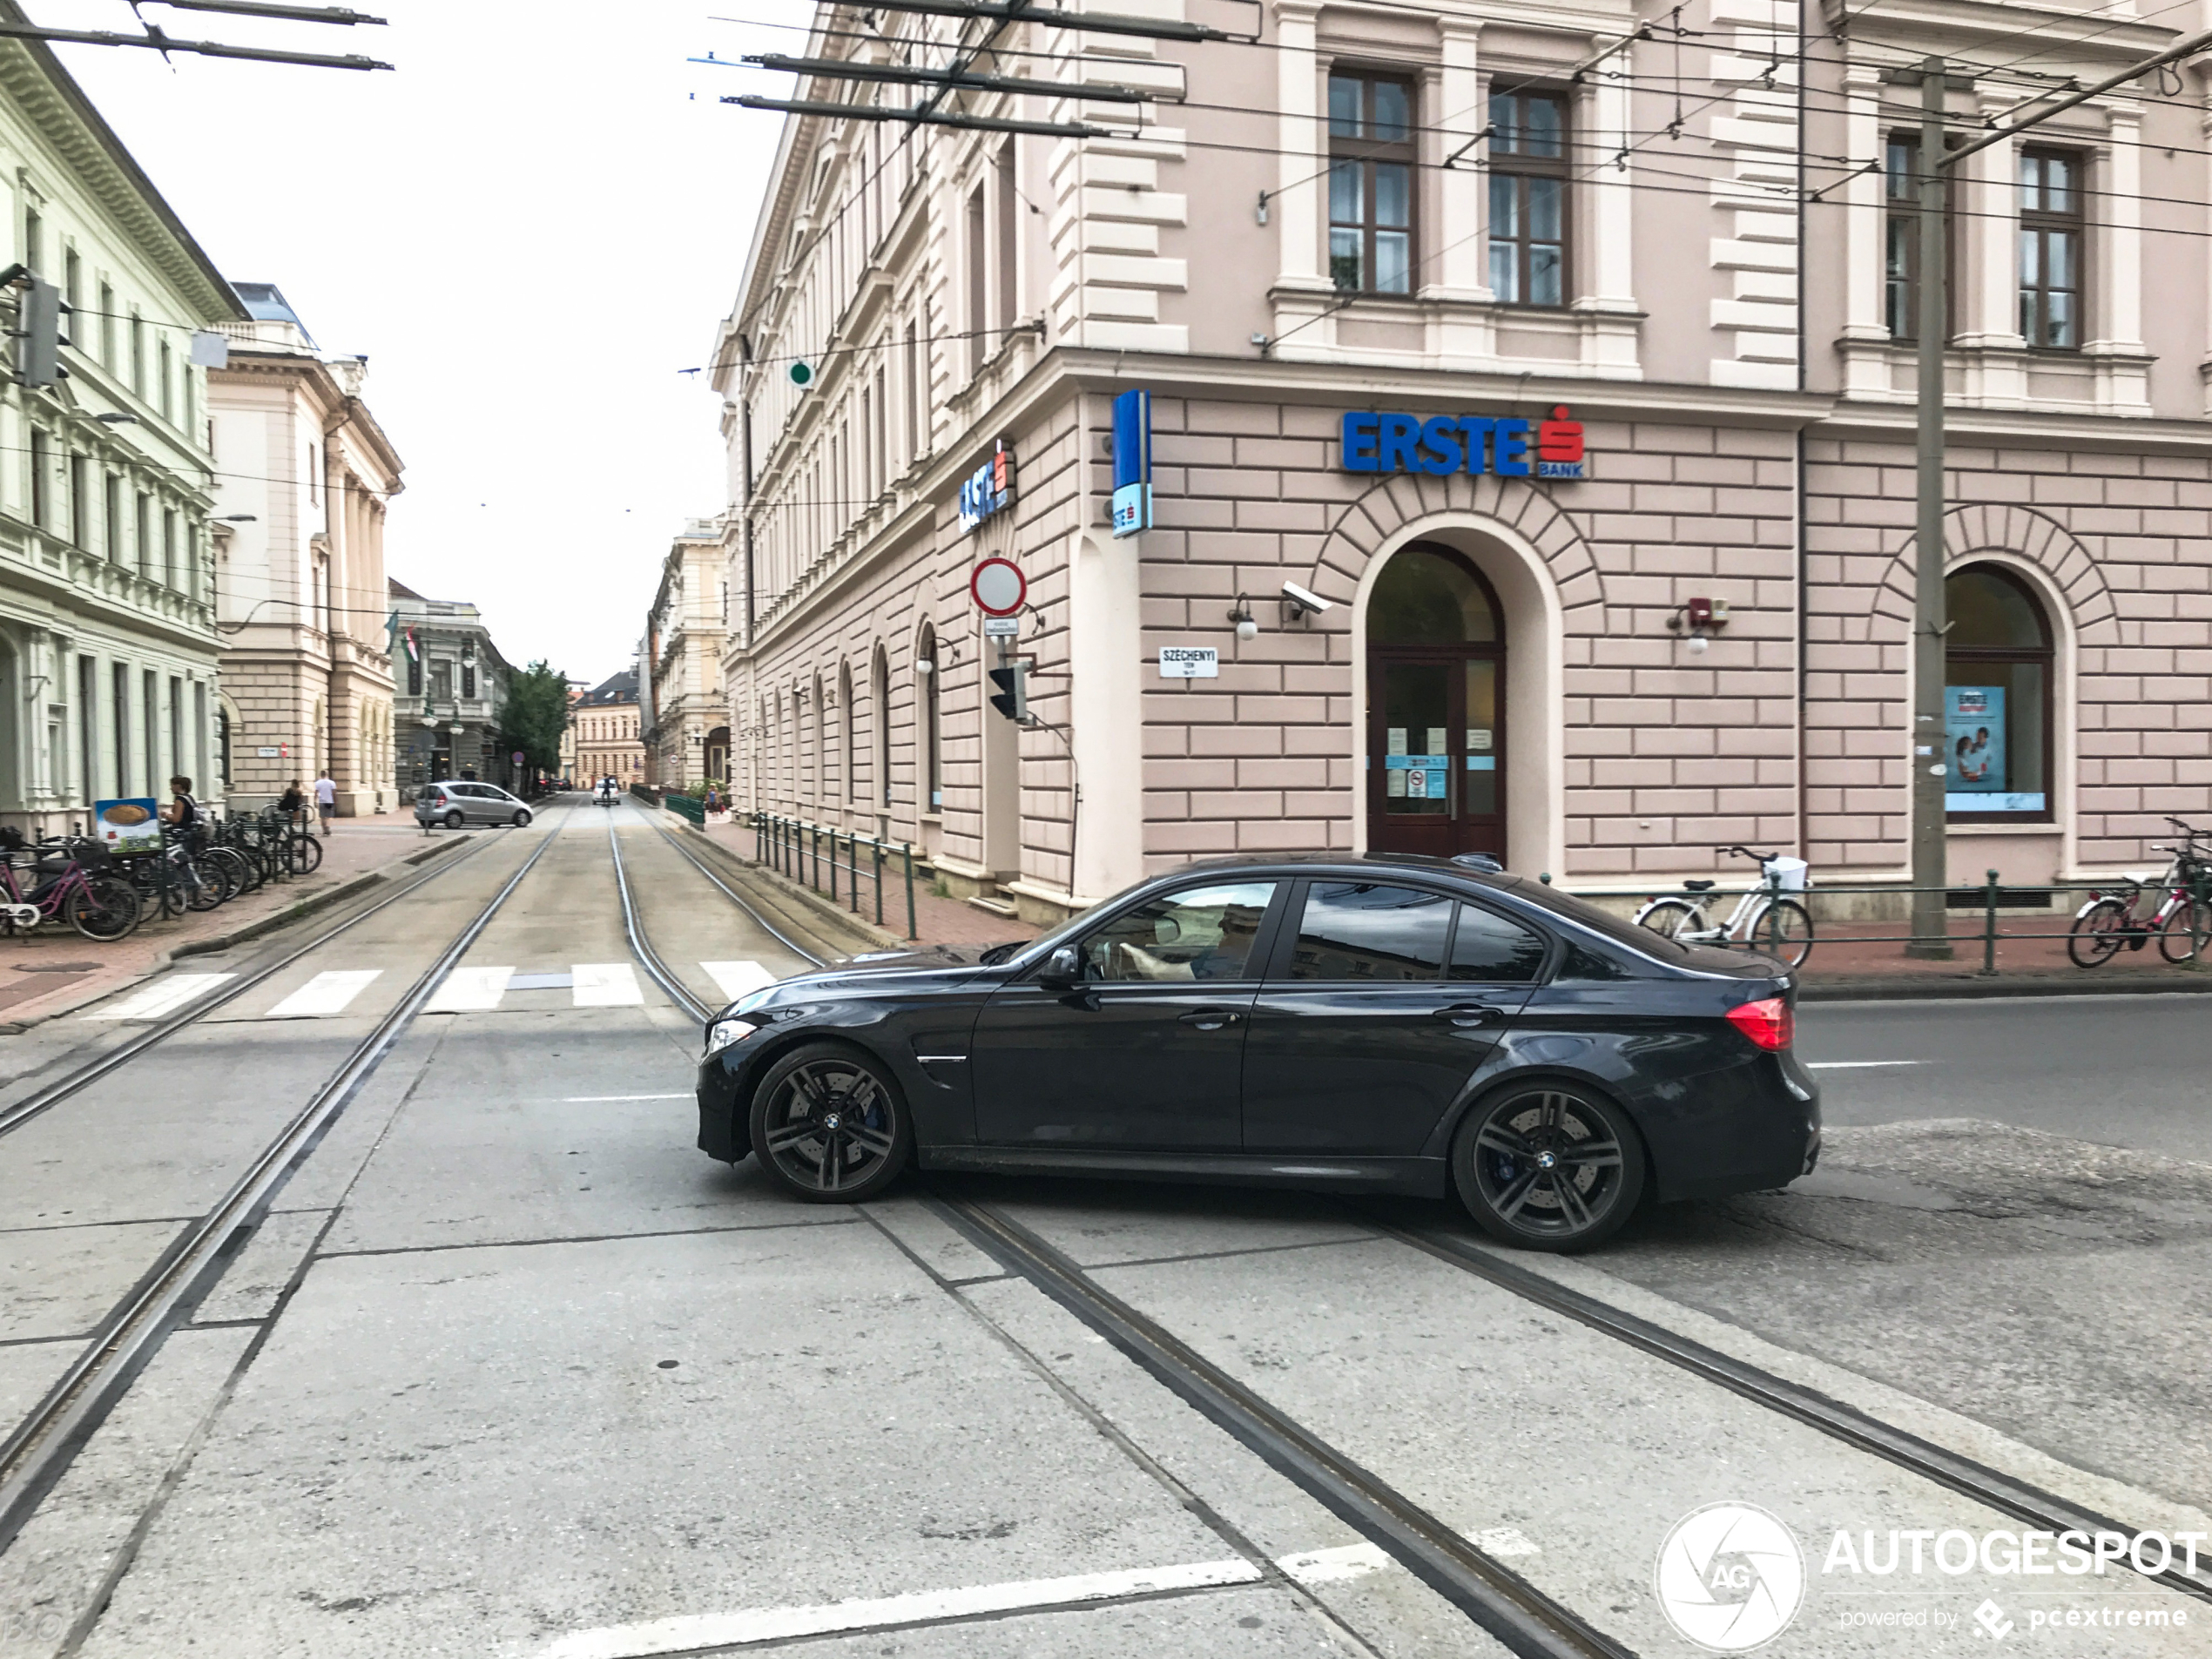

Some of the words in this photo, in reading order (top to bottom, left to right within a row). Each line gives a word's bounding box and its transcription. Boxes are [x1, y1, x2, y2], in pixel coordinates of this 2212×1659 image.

[1343, 412, 1529, 475] ERSTE
[1539, 463, 1583, 477] BANK
[1163, 649, 1215, 661] SZÉCHENYI
